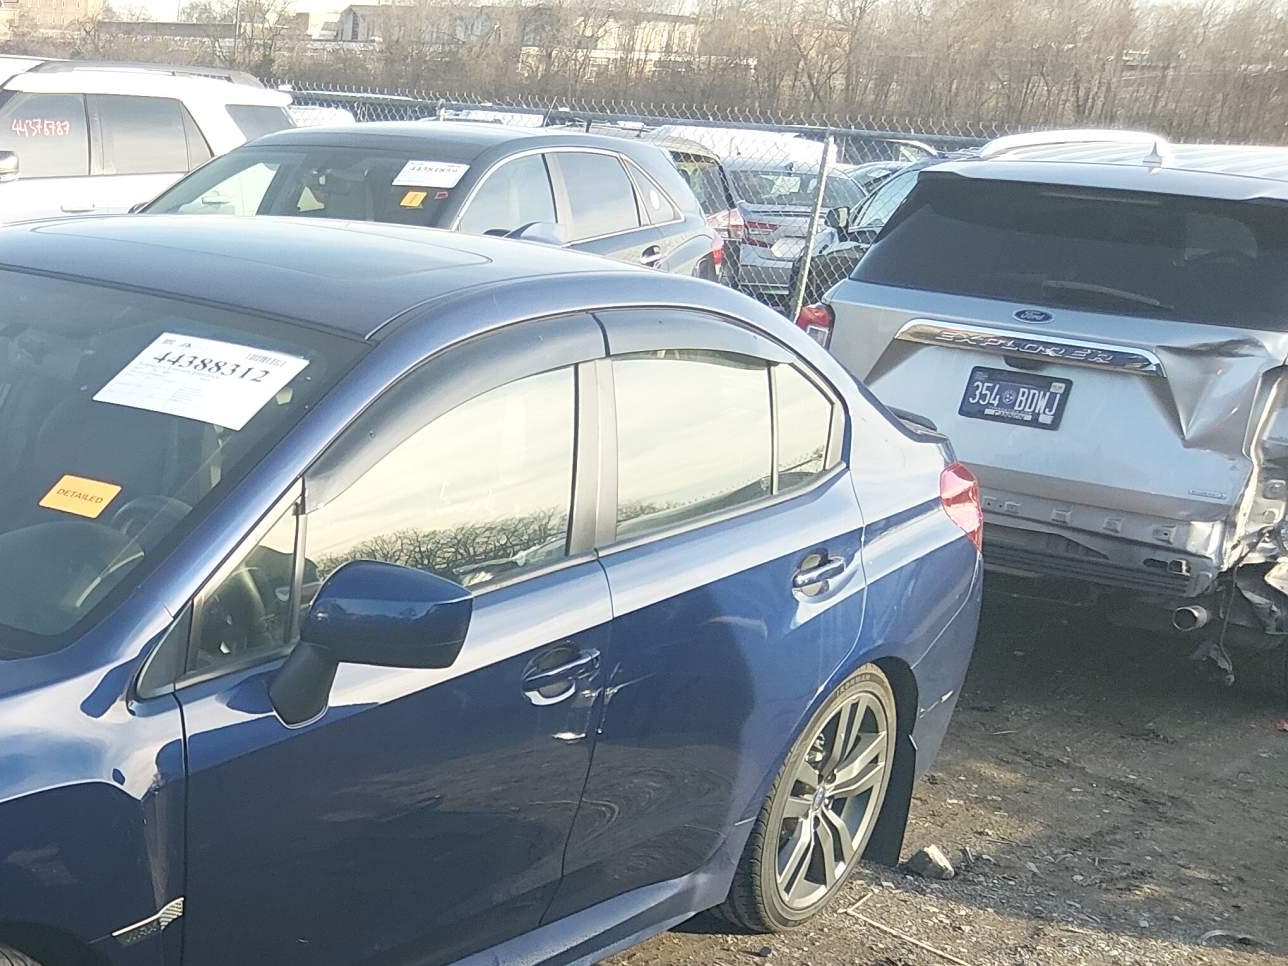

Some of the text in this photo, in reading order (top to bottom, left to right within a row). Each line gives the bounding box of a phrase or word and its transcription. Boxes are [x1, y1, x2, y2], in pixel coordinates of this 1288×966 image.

[936, 329, 1114, 364] EXPLORER
[153, 351, 270, 382] 44388312
[969, 381, 1000, 407] 354
[56, 488, 104, 504] DETAILED
